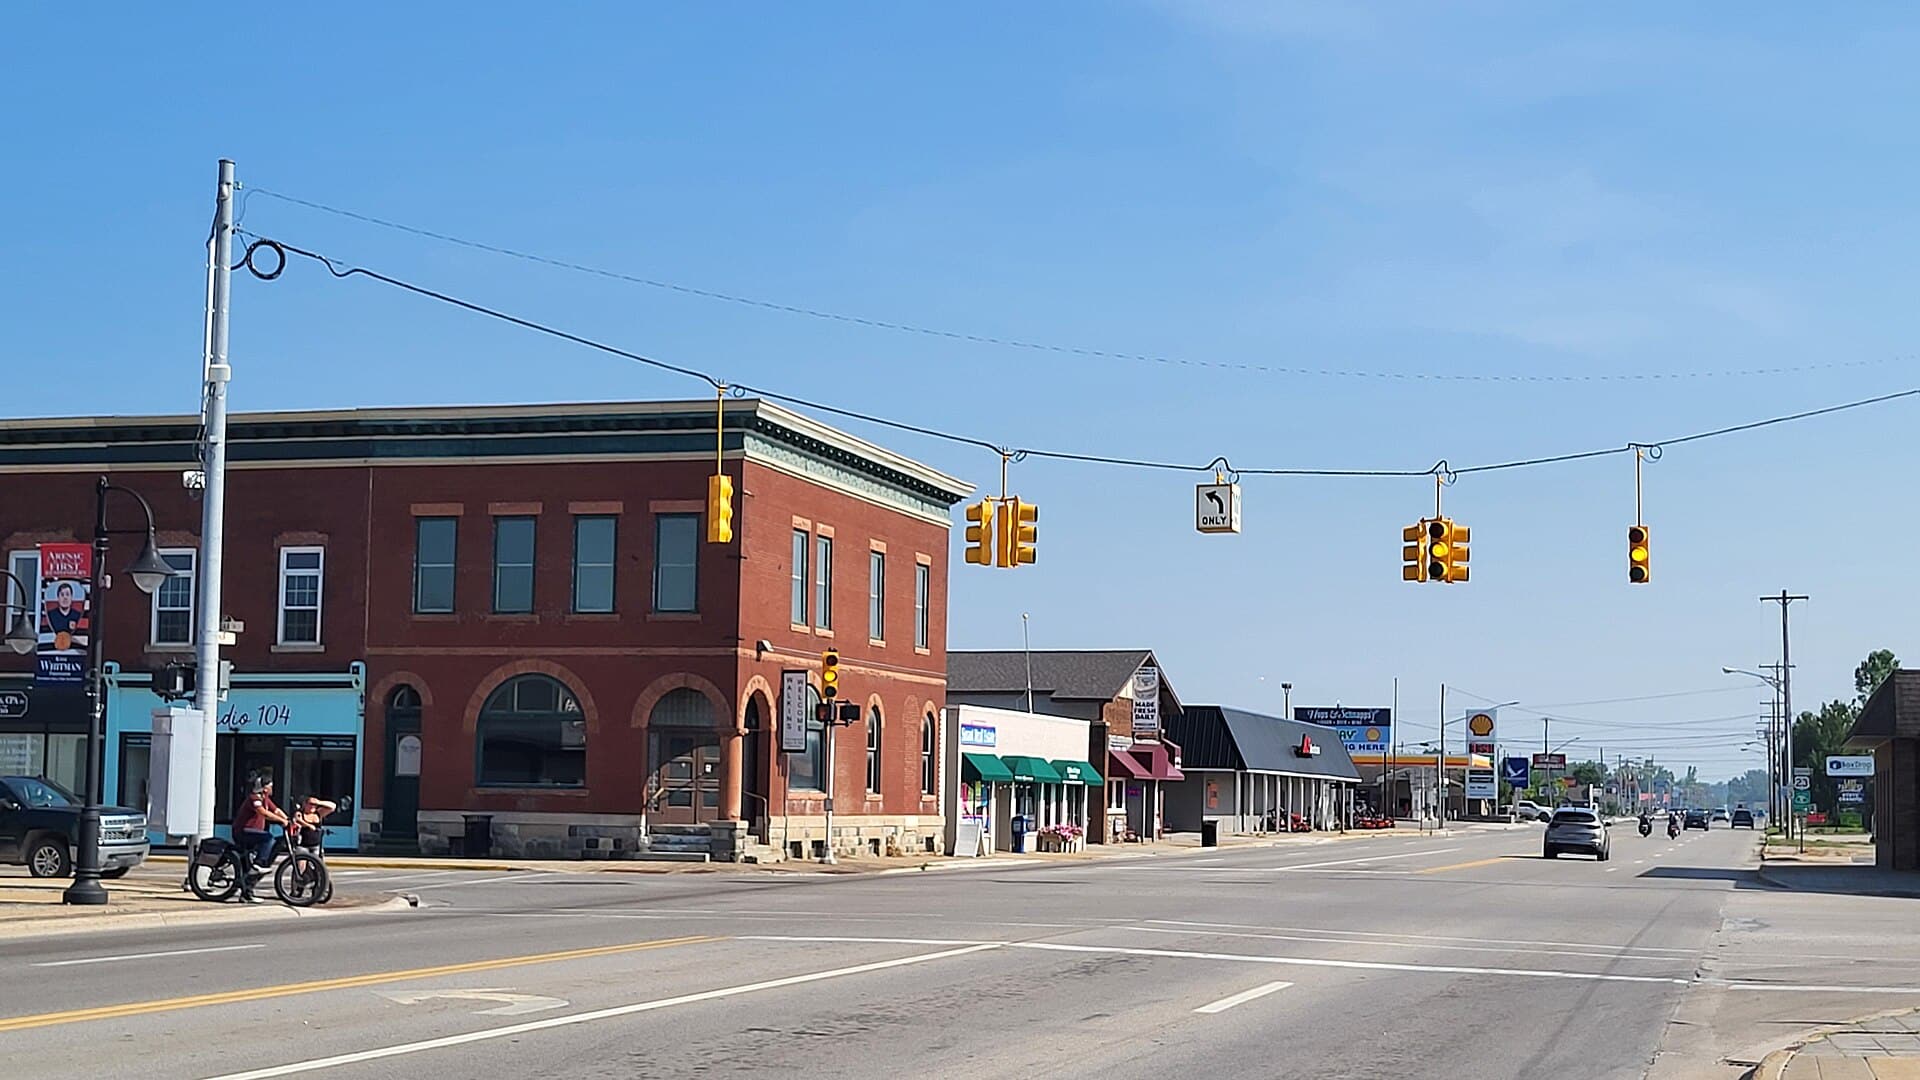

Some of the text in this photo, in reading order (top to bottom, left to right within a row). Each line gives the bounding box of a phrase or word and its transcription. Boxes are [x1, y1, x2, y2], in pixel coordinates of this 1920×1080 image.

[1202, 516, 1226, 525] ONLY
[48, 551, 84, 561] ARENAC
[49, 562, 80, 571] FIRST
[40, 660, 82, 671] WHITMAN
[257, 704, 290, 726] 104
[1358, 743, 1385, 751] HERE
